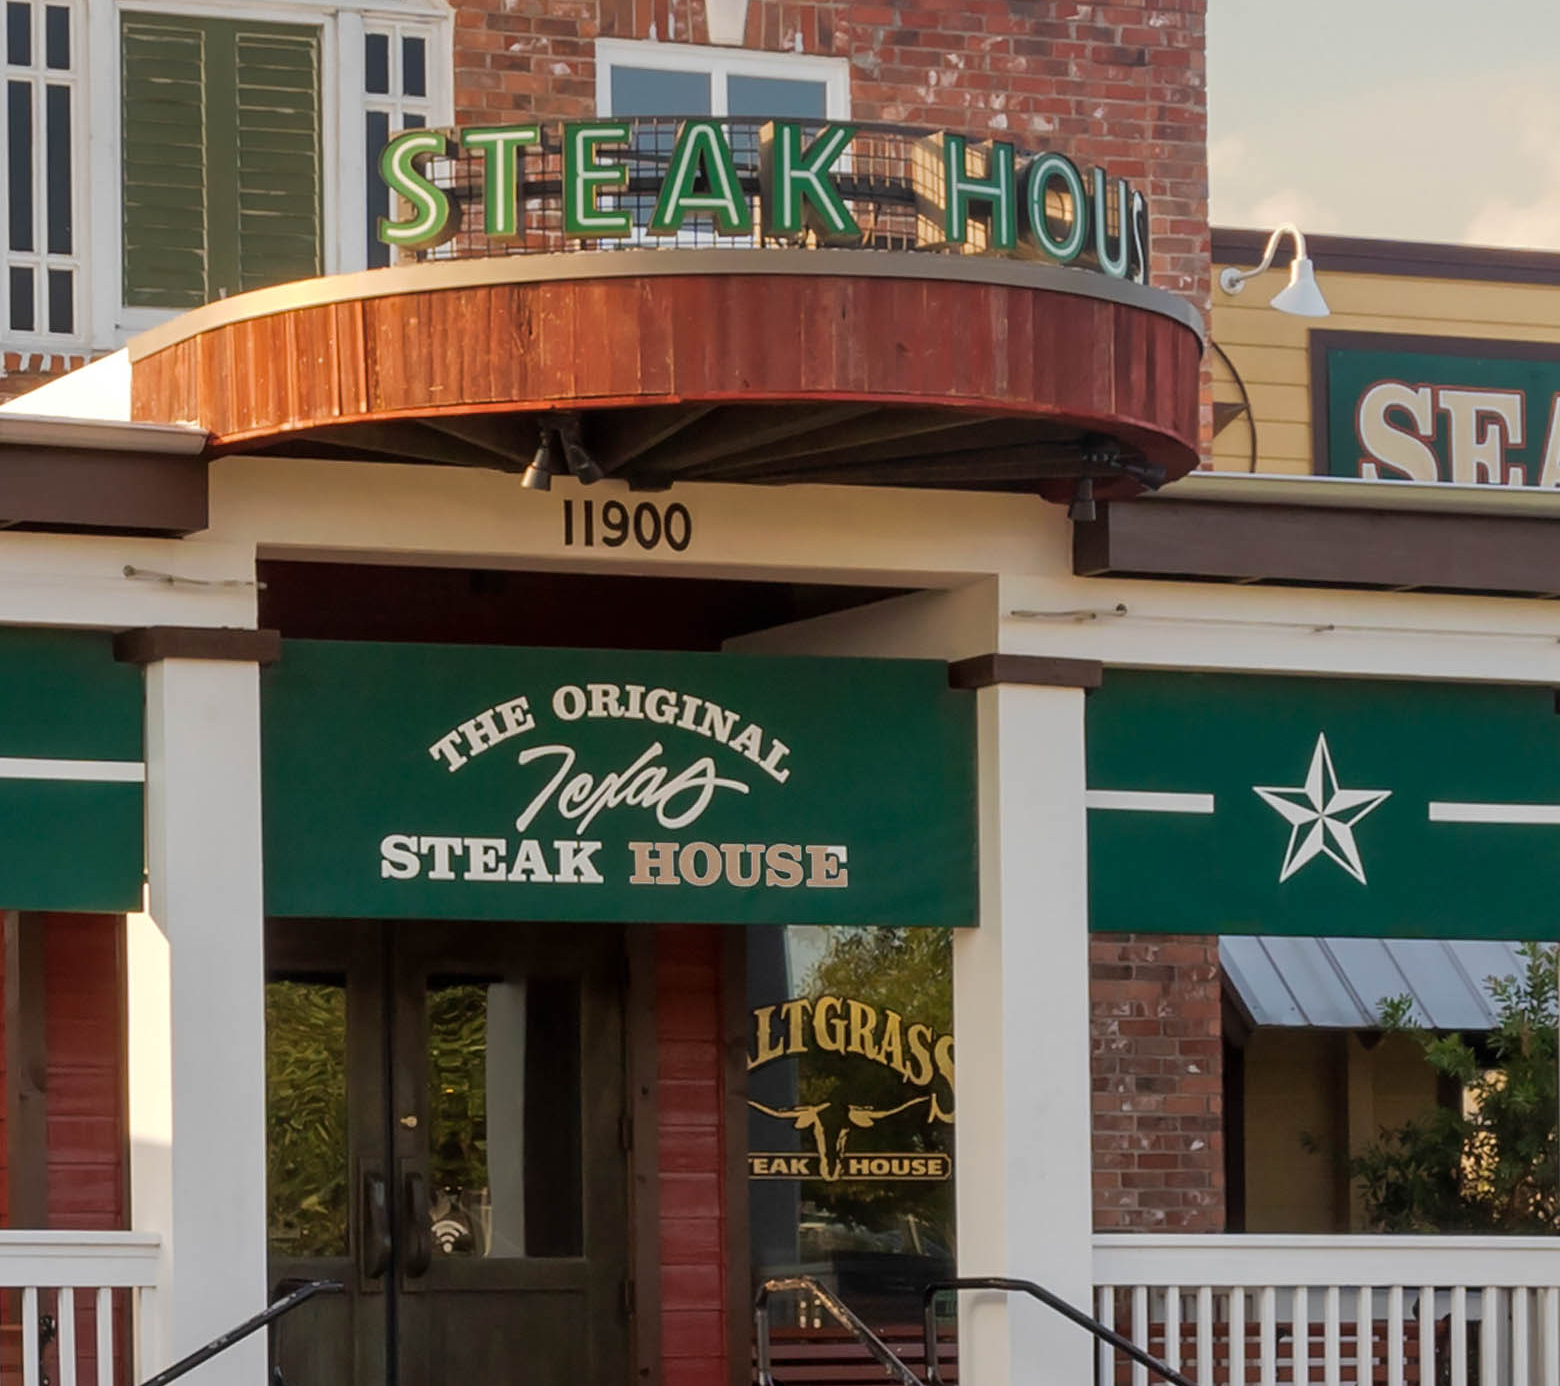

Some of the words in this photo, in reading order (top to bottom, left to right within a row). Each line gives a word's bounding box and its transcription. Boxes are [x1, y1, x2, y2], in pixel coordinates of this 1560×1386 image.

[378, 121, 862, 250] STEAK
[563, 499, 692, 552] 11900
[429, 695, 536, 773] THE
[552, 683, 791, 783] ORIGINAL
[516, 742, 750, 835] Texas
[380, 834, 604, 885] STEAK
[628, 841, 849, 889] HOUSE
[748, 1156, 809, 1175] EAK
[849, 1158, 943, 1175] HOUSE
